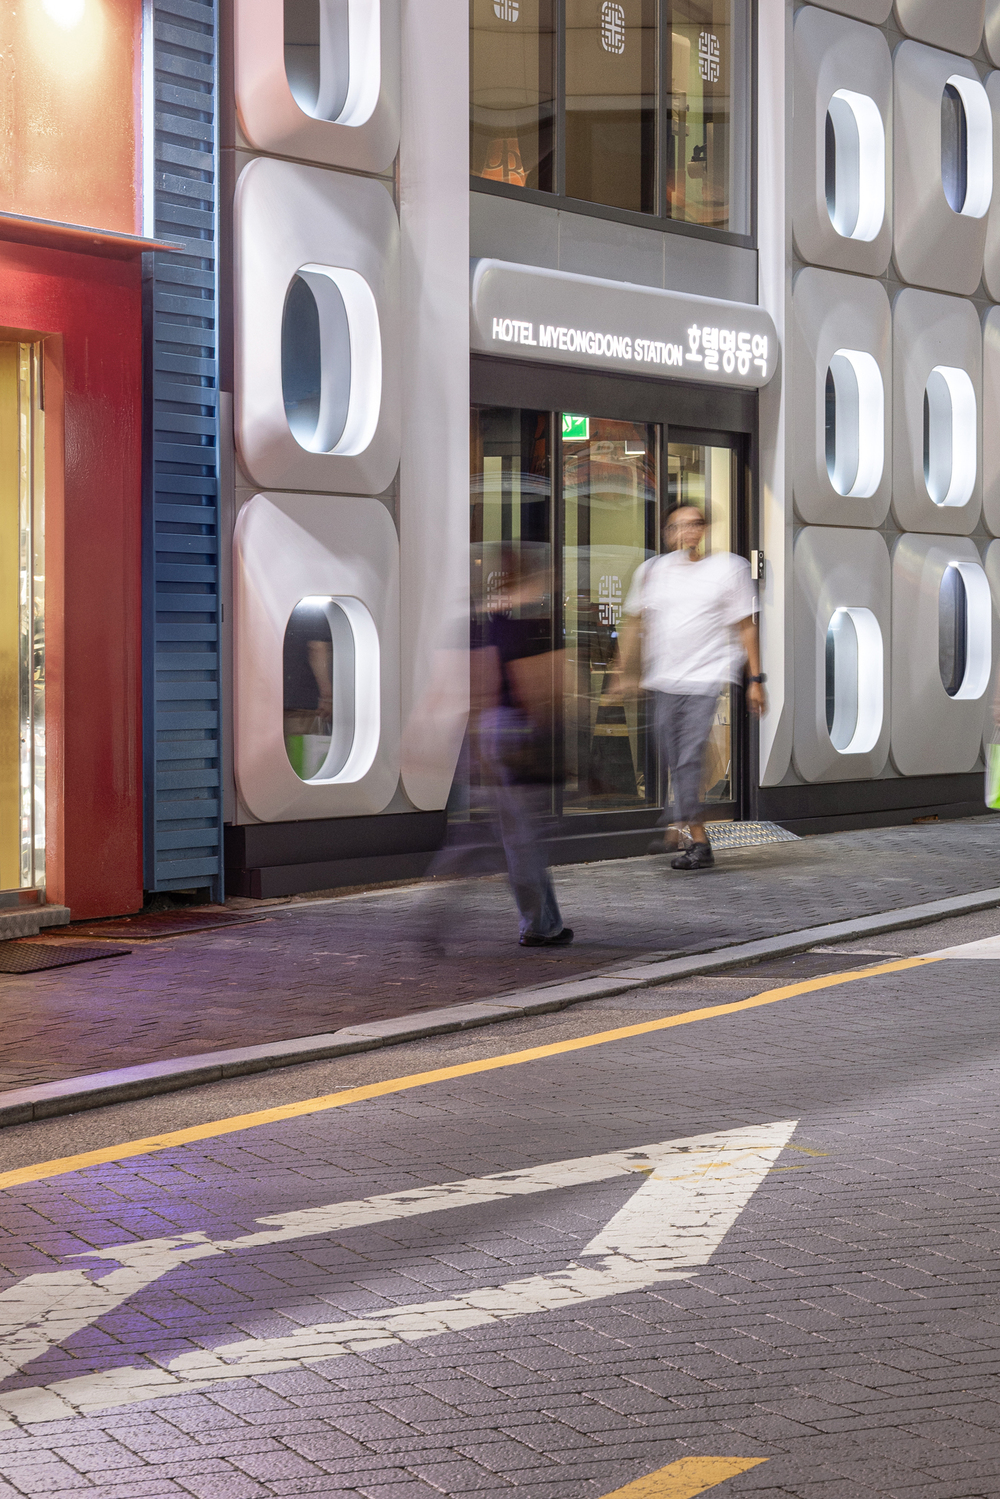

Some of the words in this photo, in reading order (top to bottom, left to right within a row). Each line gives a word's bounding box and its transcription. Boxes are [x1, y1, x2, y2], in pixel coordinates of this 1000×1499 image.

[492, 317, 537, 346] HOTEL
[539, 324, 633, 360] MYEONGDONG
[634, 338, 683, 367] STATION
[685, 324, 768, 378] 호텔명동역
